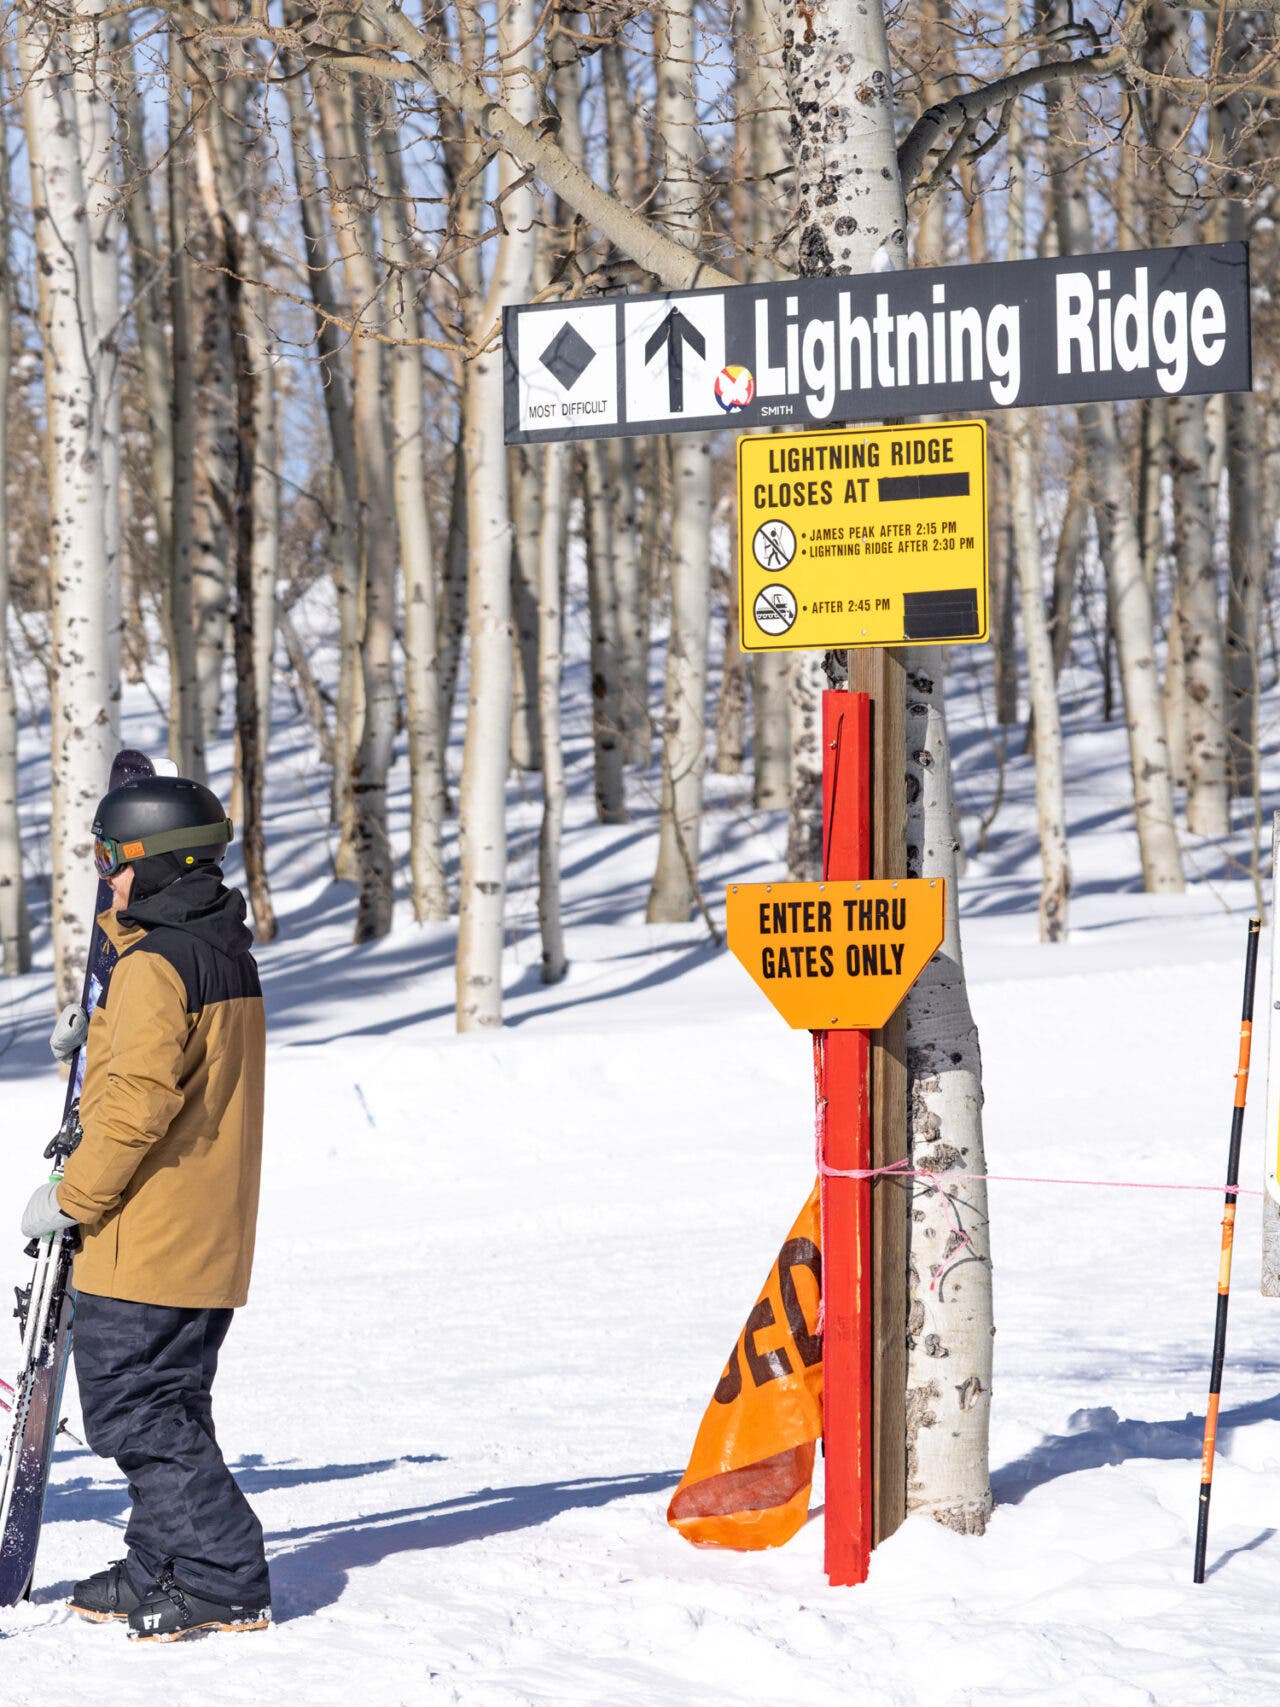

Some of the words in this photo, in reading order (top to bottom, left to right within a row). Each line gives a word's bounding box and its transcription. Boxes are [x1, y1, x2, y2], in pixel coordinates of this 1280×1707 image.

[754, 283, 1021, 419] Lightning
[1055, 266, 1227, 394] Ridge
[529, 404, 556, 418] MOST
[561, 400, 607, 416] DIFFICULT
[760, 405, 794, 417] SMITH
[769, 442, 880, 474] LIGHTNING
[891, 438, 954, 466] RIDGE
[754, 480, 833, 509] CLOSES
[844, 478, 870, 504] AT
[810, 527, 845, 542] JAMES
[849, 526, 875, 539] PEAK
[880, 524, 912, 537] AFTER
[916, 522, 937, 535] 2:15
[941, 521, 957, 534] PM
[809, 543, 861, 558] LIGHTNING
[865, 541, 893, 555] RIDGE
[898, 540, 929, 553] AFTER
[933, 538, 955, 551] 2:30
[959, 537, 975, 550] PM
[812, 601, 843, 614] AFTER
[848, 599, 871, 612] 2:45
[875, 598, 891, 611] PM
[759, 901, 832, 934] ENTER
[843, 898, 906, 932] THRU
[761, 945, 834, 979] GATES
[846, 943, 905, 976] ONLY
